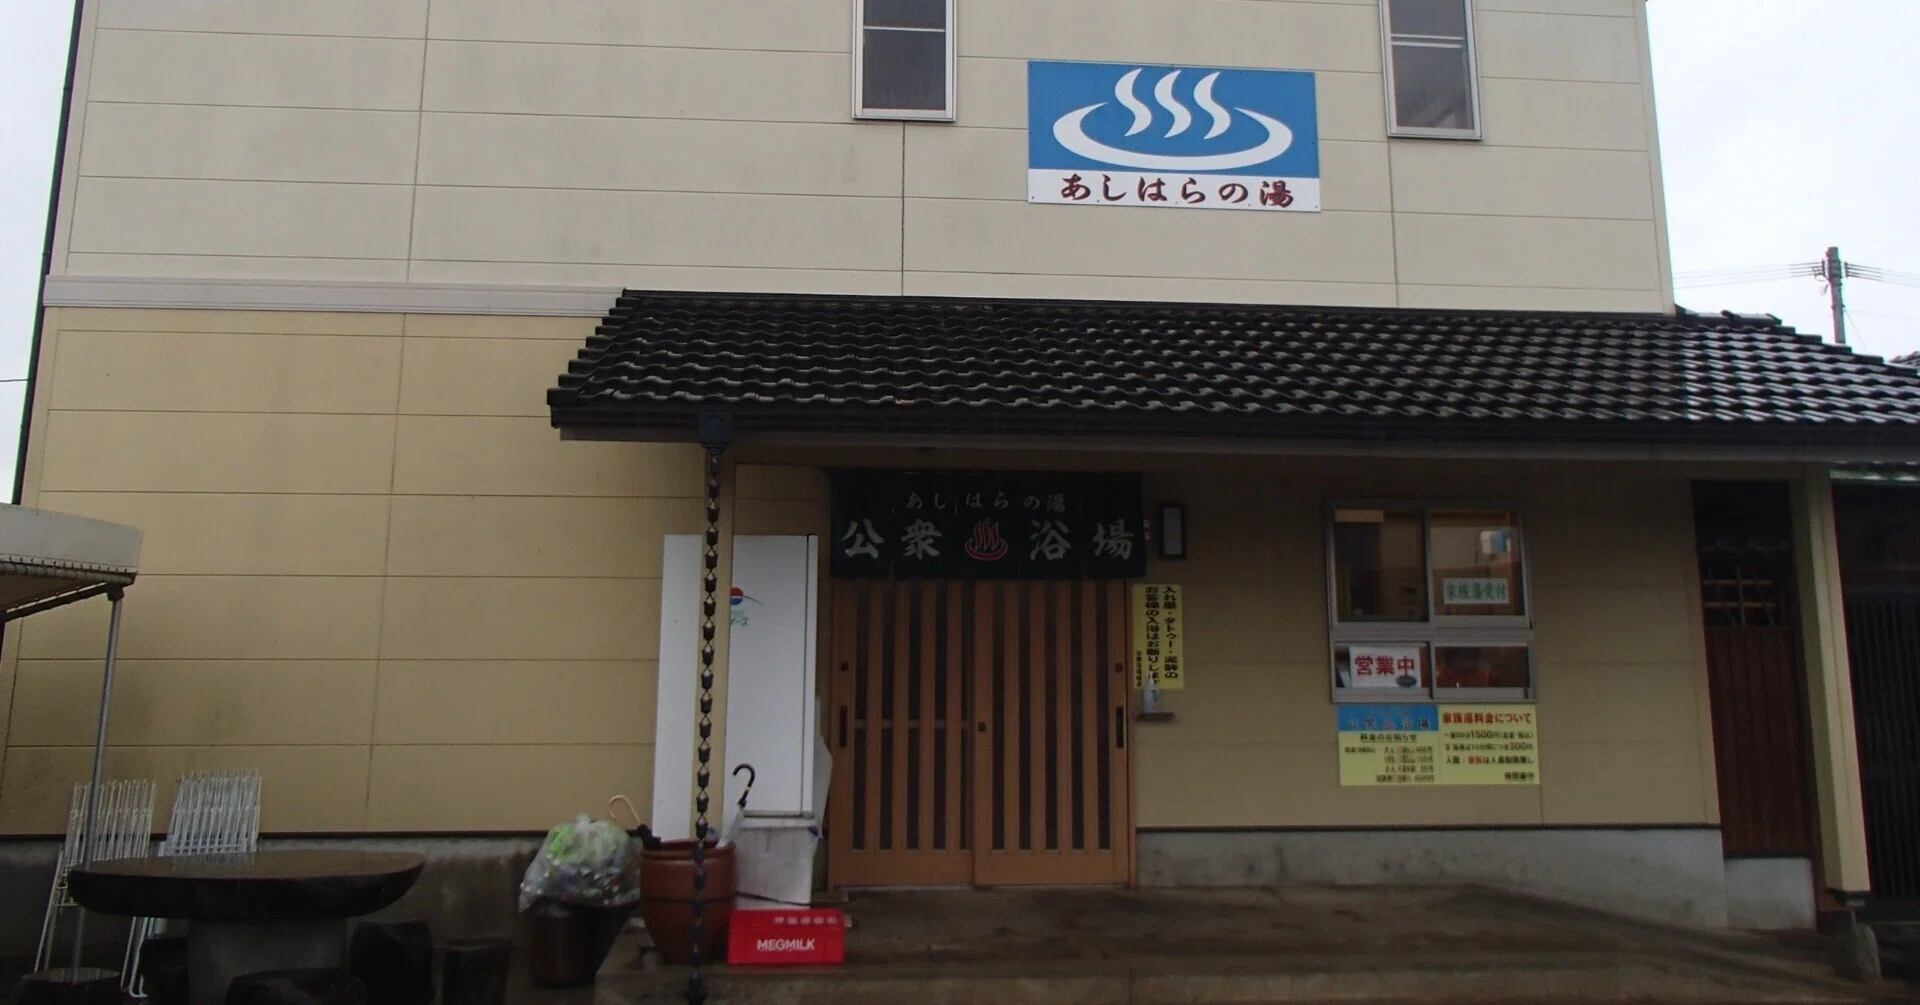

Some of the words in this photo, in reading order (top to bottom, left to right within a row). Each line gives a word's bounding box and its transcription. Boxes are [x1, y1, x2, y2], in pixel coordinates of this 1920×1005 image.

[1061, 173, 1294, 208] あしはらの湯
[906, 492, 1066, 513] あしはらの湯
[1354, 655, 1415, 676] 営業中
[757, 938, 815, 951] MEGMILK
